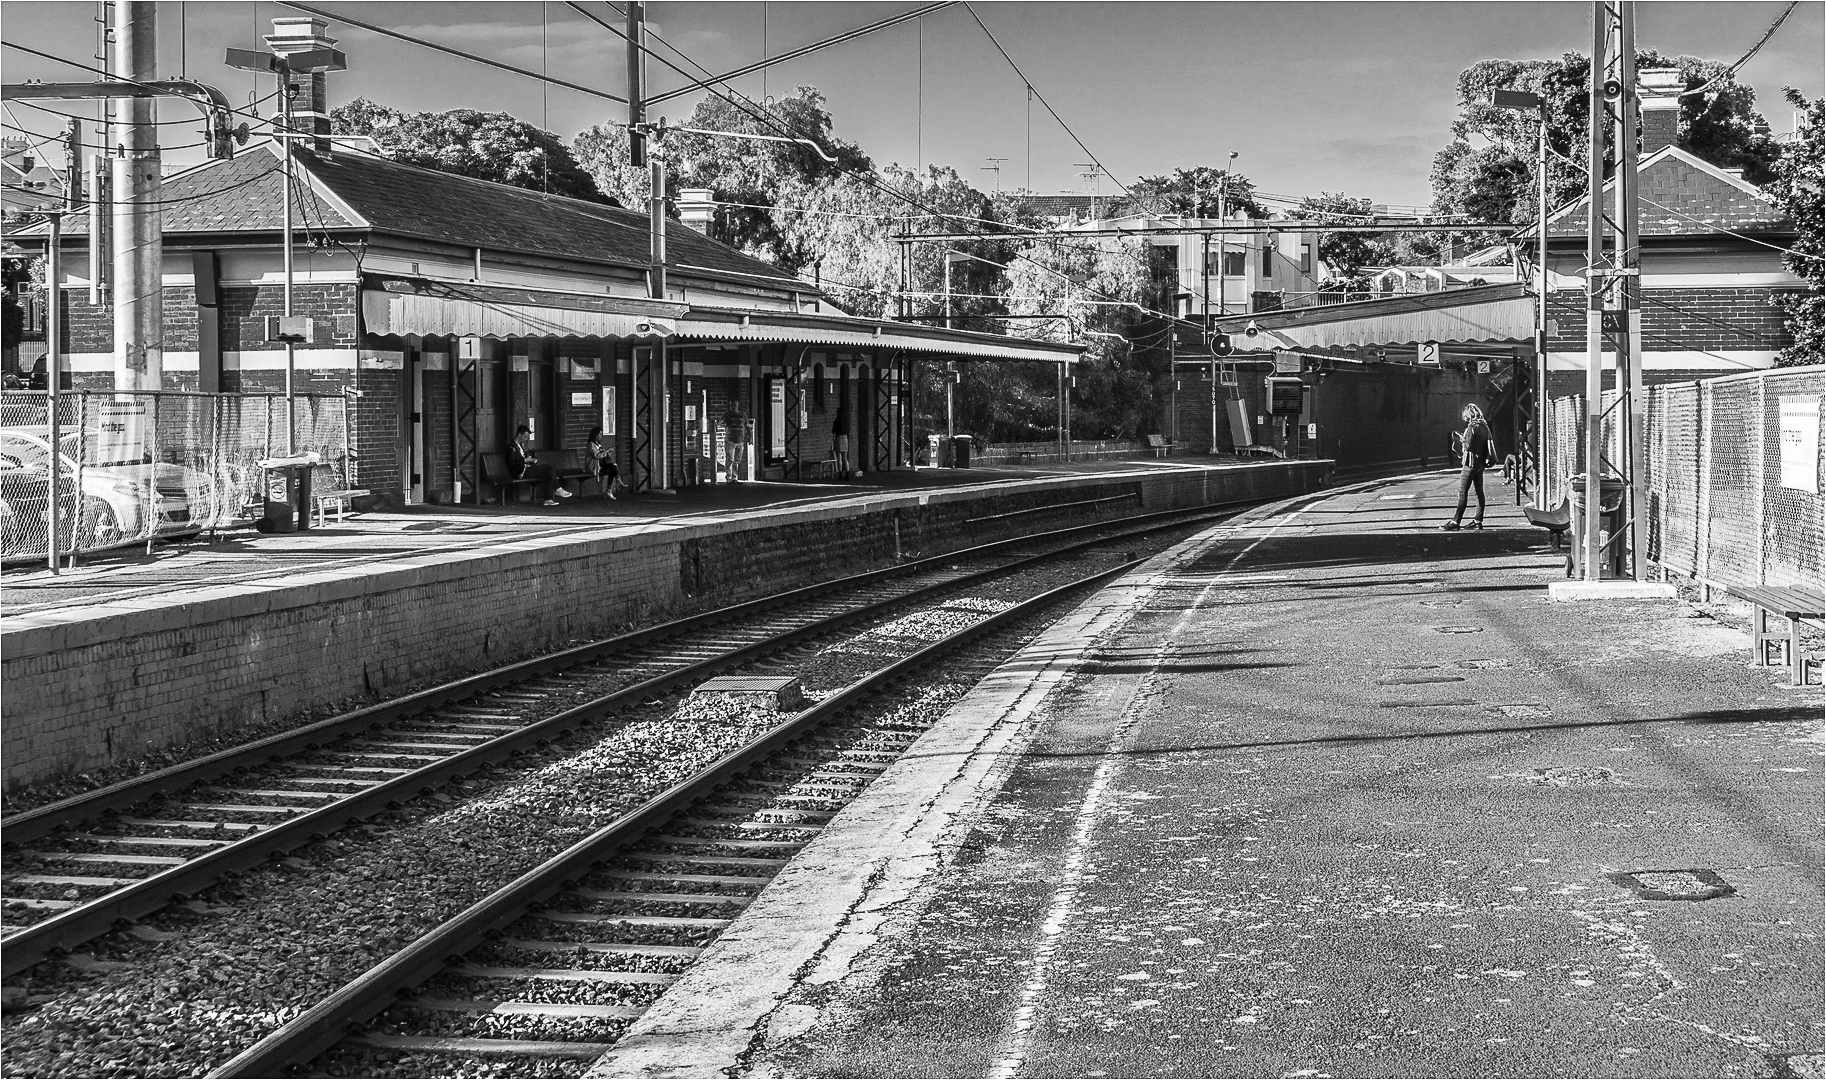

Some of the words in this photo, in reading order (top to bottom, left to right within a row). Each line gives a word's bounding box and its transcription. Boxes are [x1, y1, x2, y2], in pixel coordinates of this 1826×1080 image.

[464, 339, 472, 357] 1
[1422, 345, 1435, 362] 2
[1479, 361, 1488, 372] 2
